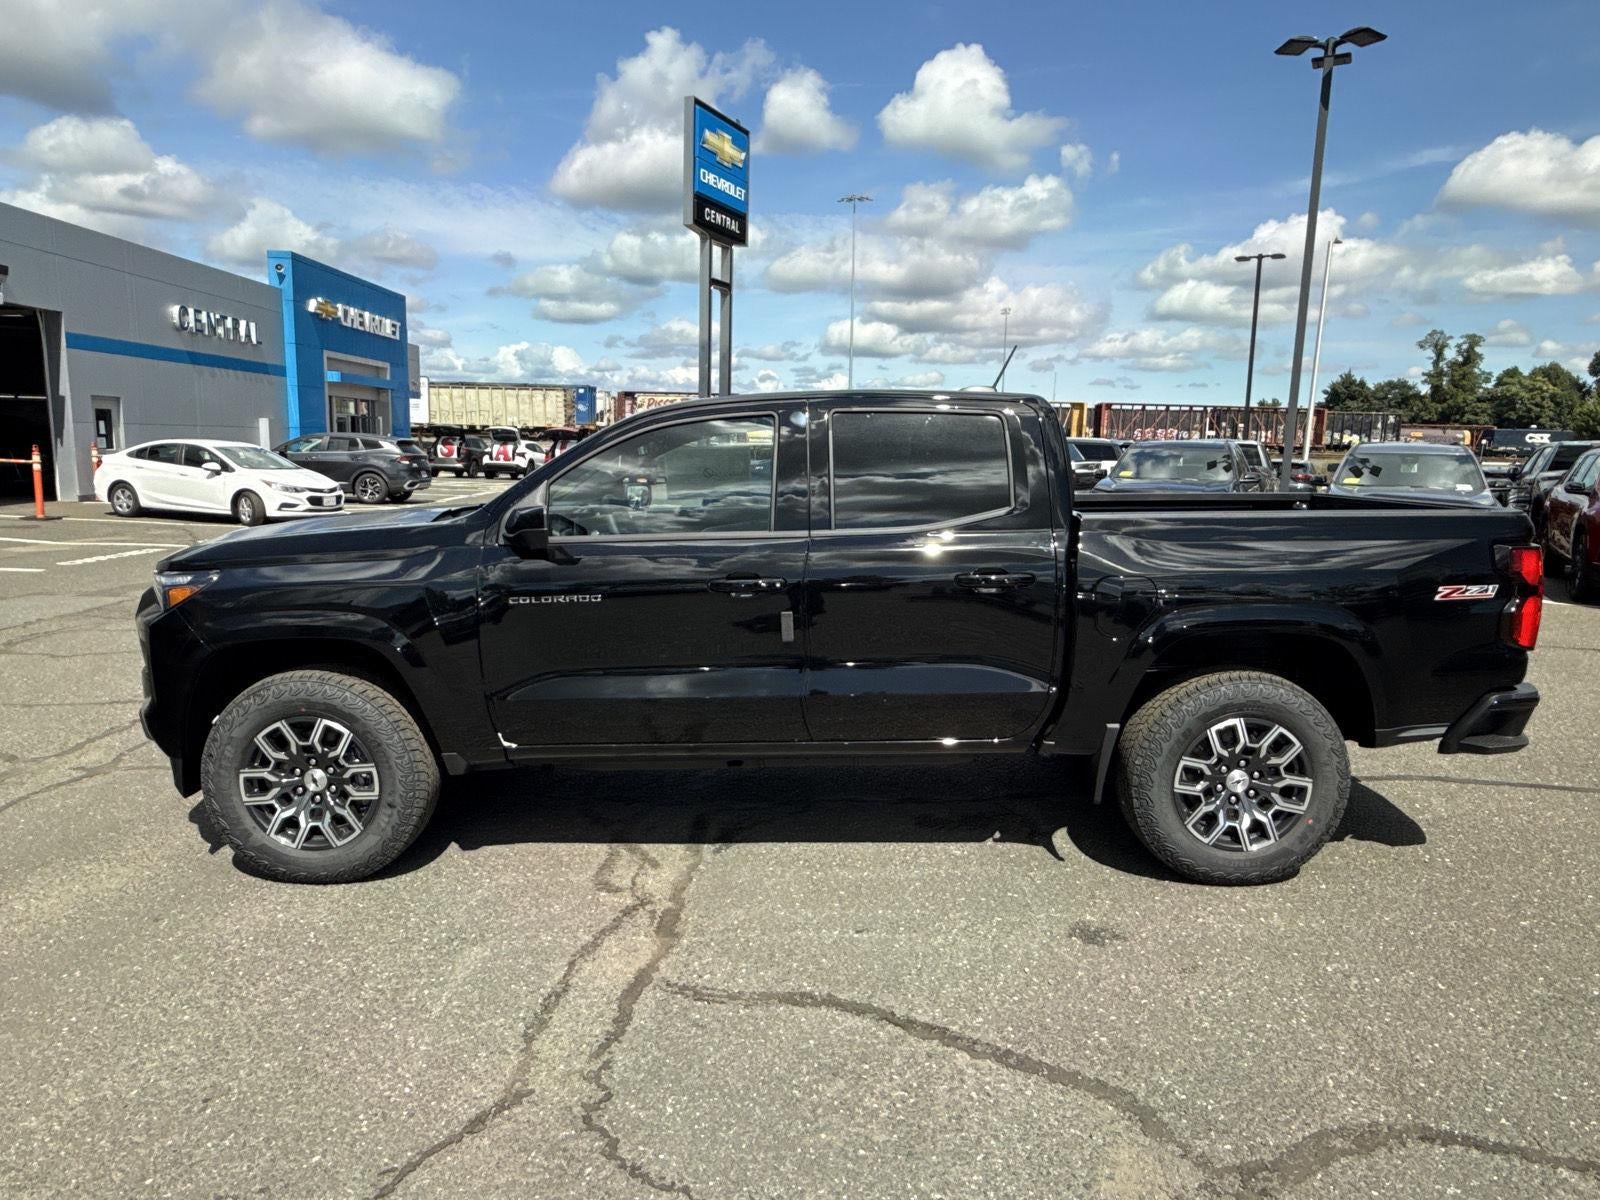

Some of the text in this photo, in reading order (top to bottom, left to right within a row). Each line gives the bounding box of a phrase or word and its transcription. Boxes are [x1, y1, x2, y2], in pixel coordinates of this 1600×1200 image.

[700, 168, 746, 201] CHEVROLET
[704, 207, 740, 234] CENTRAL
[173, 304, 263, 345] CENTRAL
[339, 303, 401, 341] CHEVROLET
[1525, 433, 1552, 444] CSX
[508, 594, 602, 605] COLORADO
[1434, 584, 1499, 601] Z71
